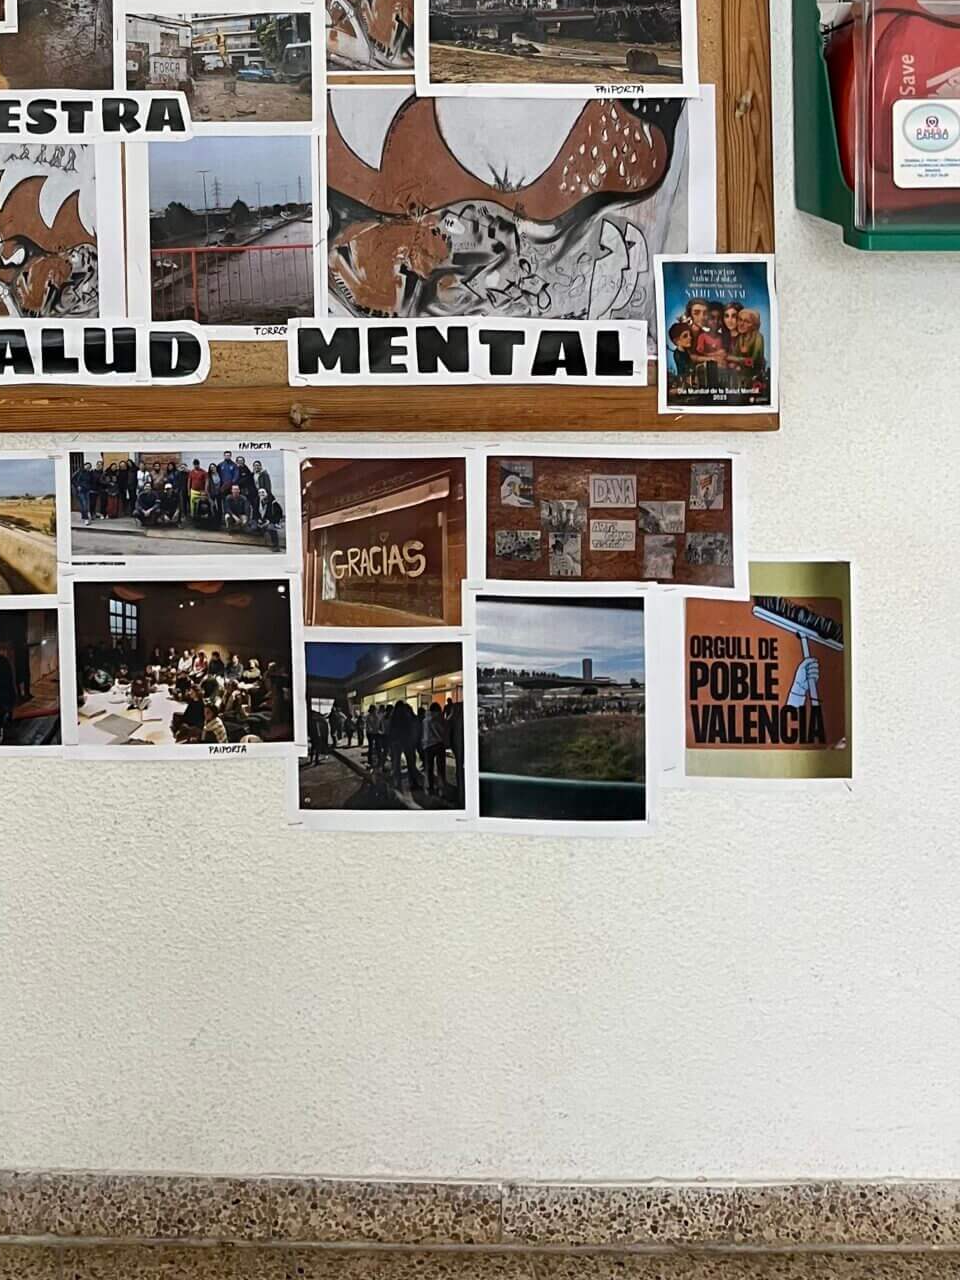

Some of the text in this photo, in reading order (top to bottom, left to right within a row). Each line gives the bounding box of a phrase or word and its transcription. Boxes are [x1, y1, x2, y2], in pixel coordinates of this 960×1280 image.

[900, 54, 916, 96] Save
[253, 326, 288, 336] TORRE
[297, 325, 634, 376] MENTAL
[330, 541, 426, 579] GRACIAS
[690, 635, 778, 660] ORGULL DE
[689, 661, 779, 701] POBLE
